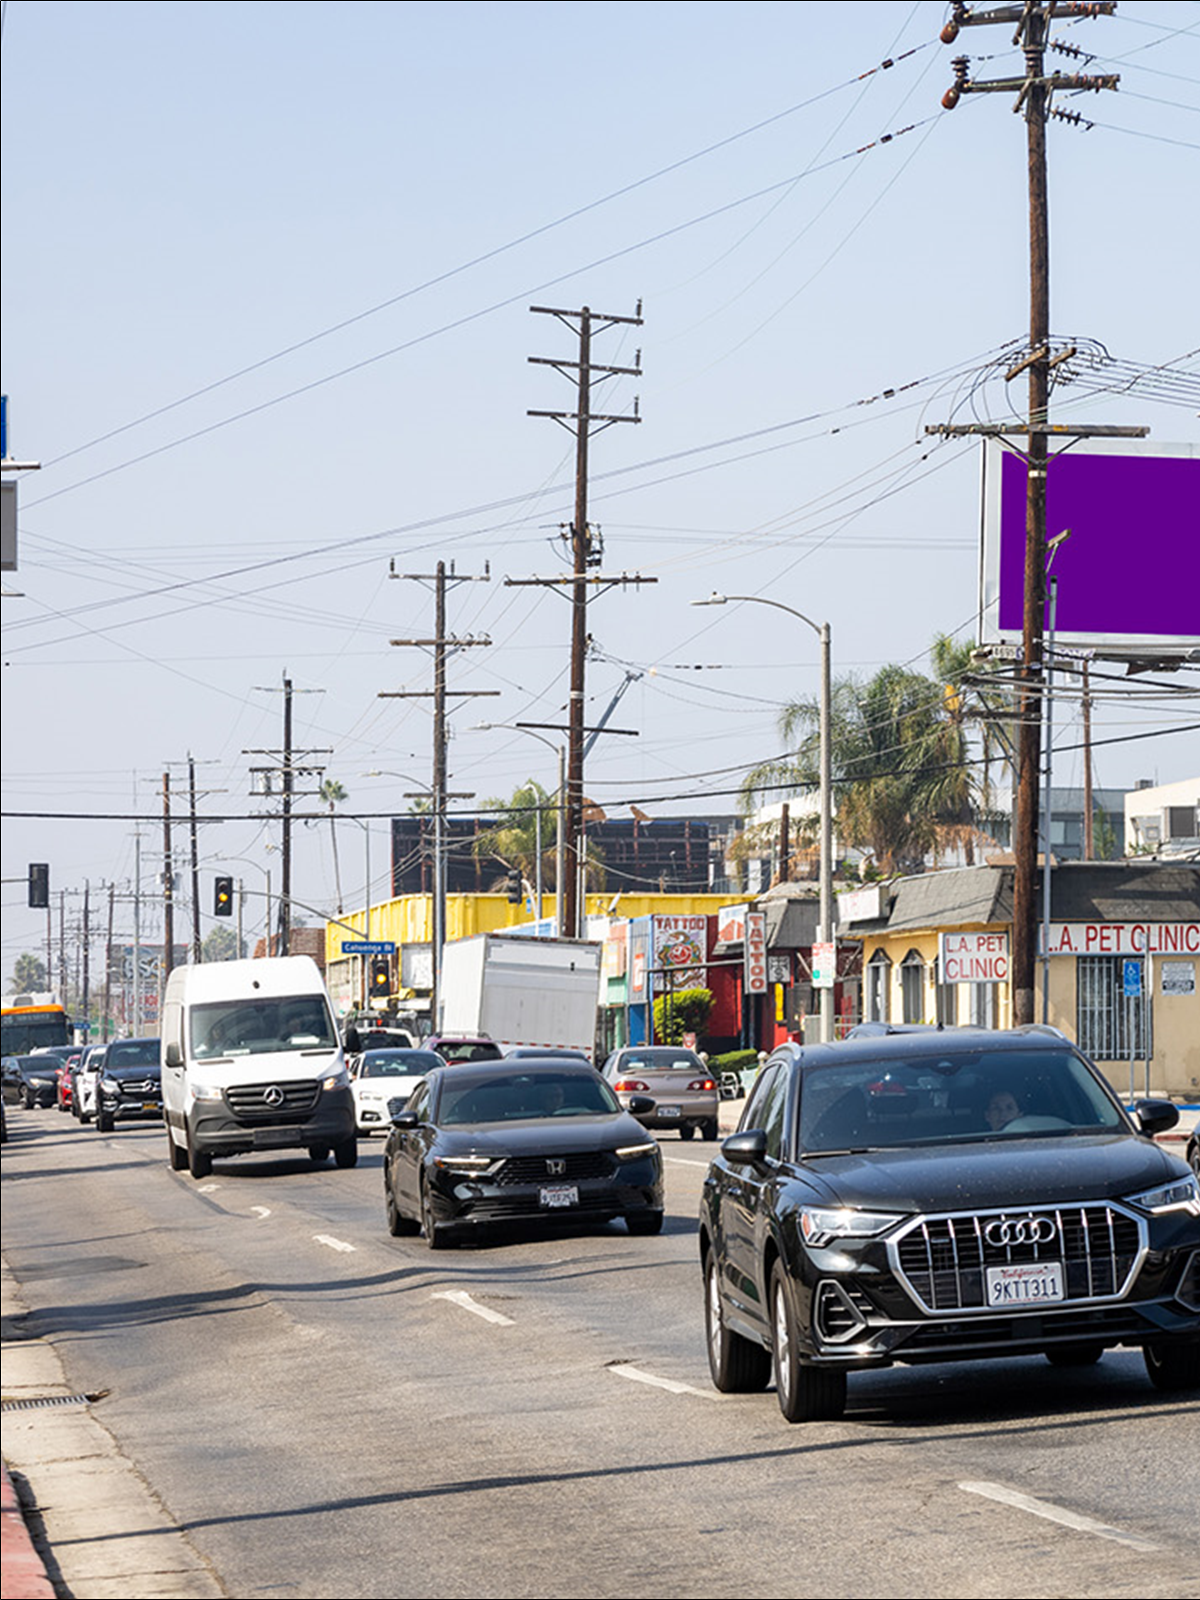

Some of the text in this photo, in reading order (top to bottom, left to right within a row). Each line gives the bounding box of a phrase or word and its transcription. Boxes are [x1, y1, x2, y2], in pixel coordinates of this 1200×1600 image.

[655, 917, 705, 930] TATTOO
[946, 935, 1005, 952] L.A. PET
[1085, 925, 1125, 952] PET
[1130, 925, 1200, 952] CLINIC
[749, 915, 765, 990] TATTOO
[945, 957, 1007, 979] CLINIC
[994, 1278, 1059, 1301] 9KTT311
